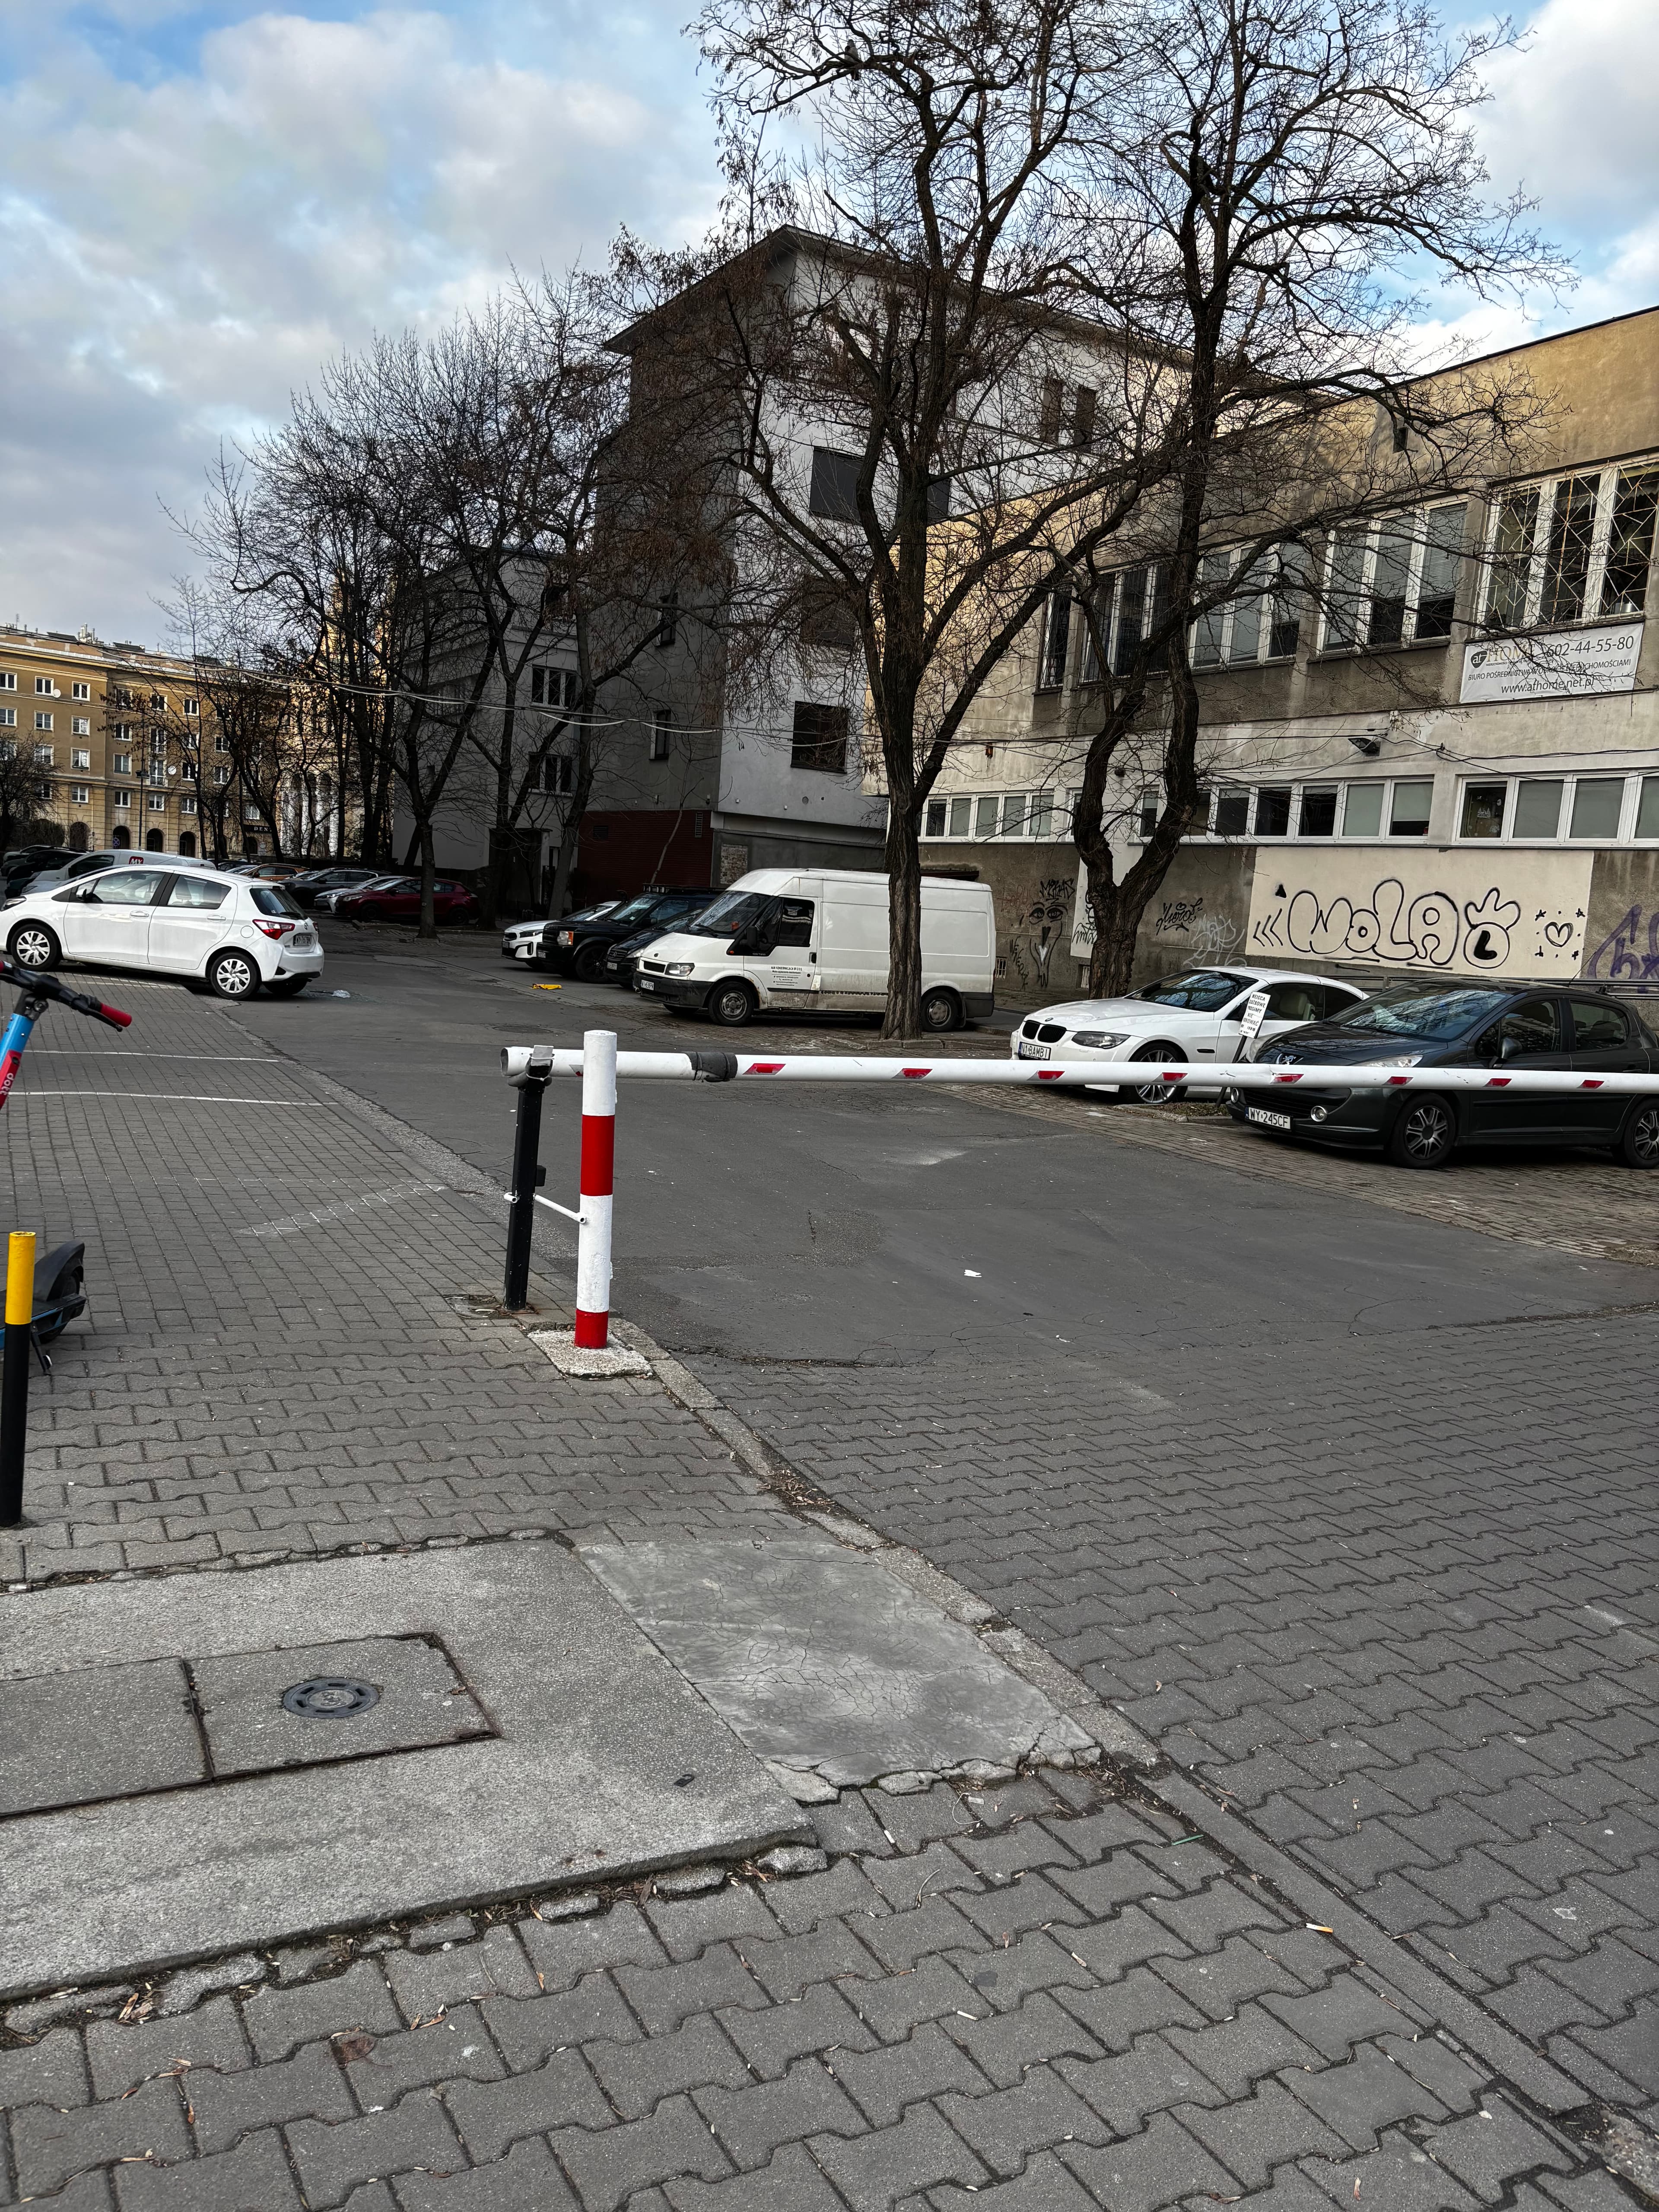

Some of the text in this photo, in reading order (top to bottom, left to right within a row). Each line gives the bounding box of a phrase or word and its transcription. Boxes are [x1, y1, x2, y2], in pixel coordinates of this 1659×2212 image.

[1243, 1018, 1259, 1026] KOWAĆ
[1029, 1046, 1047, 1058] BAMBI
[1250, 1108, 1288, 1127] WY 245CF
